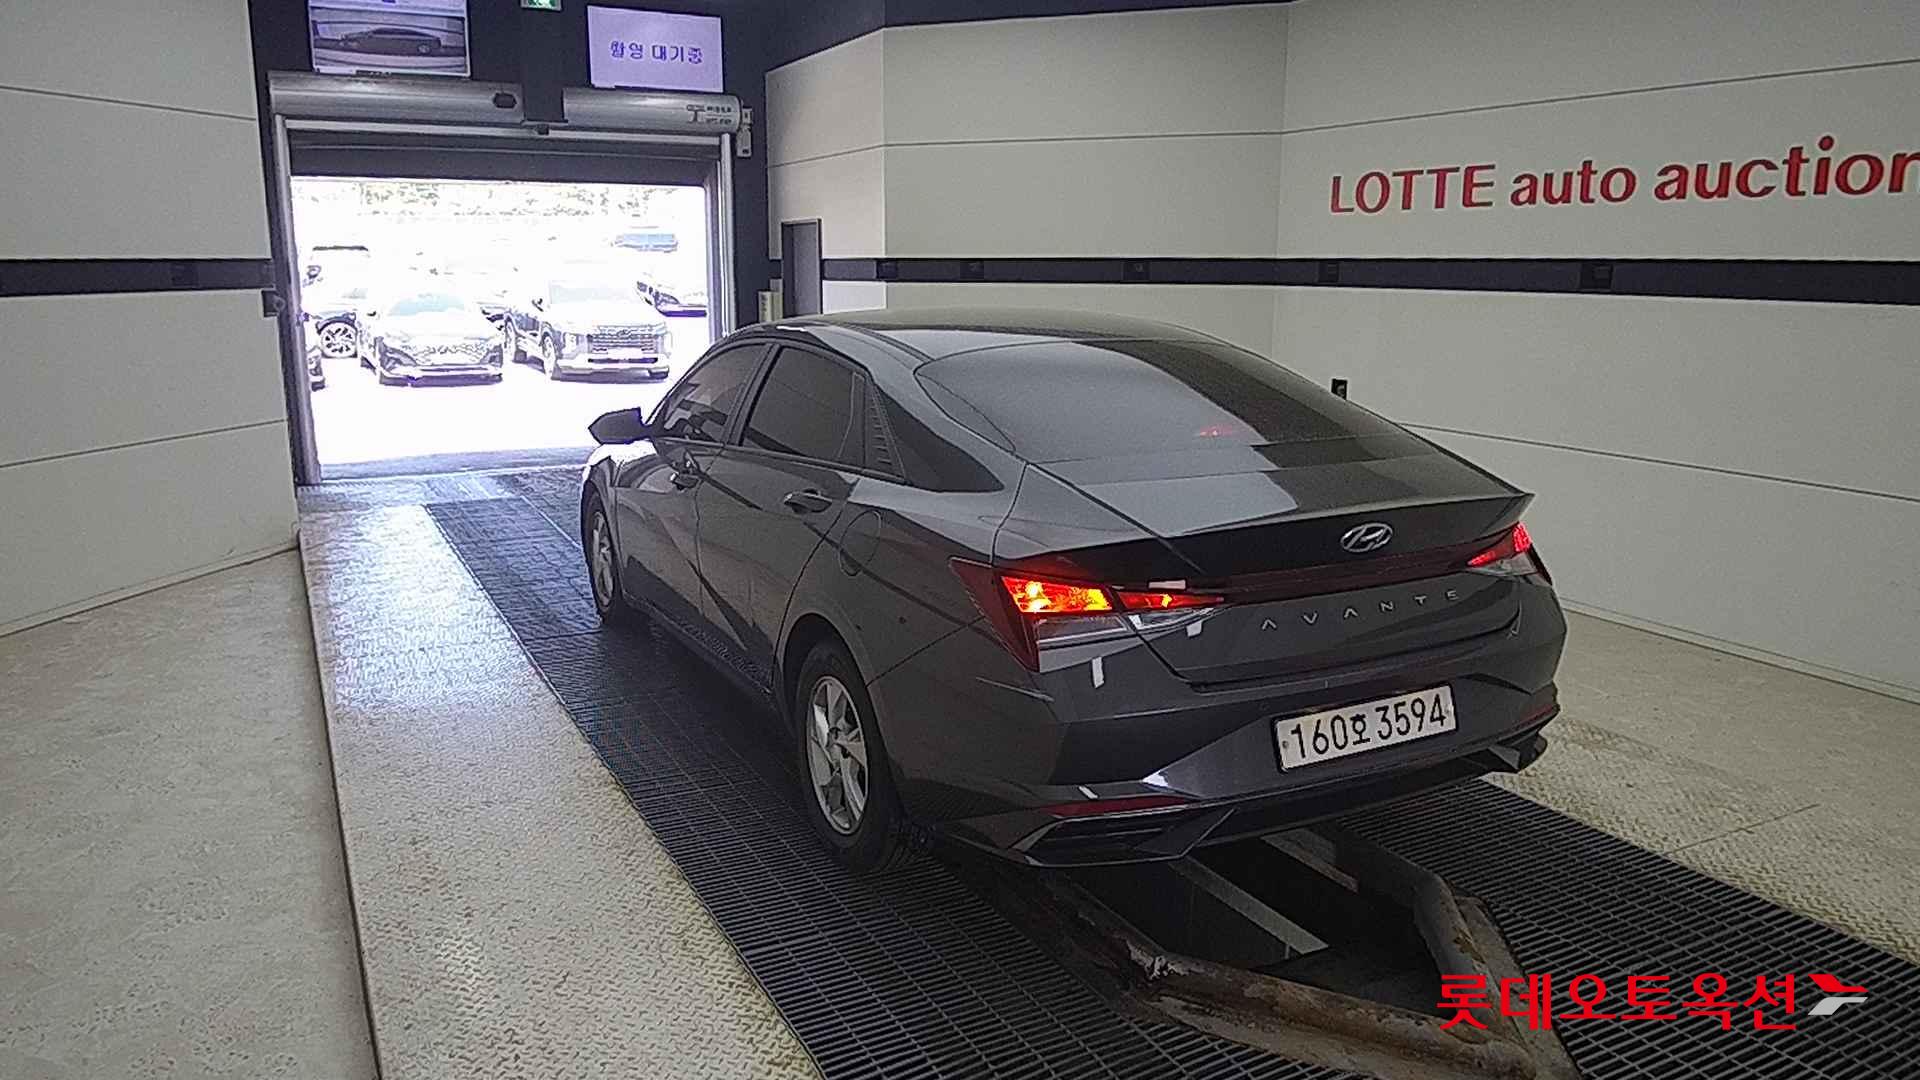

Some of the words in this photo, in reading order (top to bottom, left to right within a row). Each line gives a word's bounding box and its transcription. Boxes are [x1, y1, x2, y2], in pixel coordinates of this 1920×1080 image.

[1330, 163, 1497, 214] LOTTE
[1510, 160, 1638, 206] auto
[1261, 589, 1460, 631] AVANTE
[1374, 693, 1447, 741] 3594
